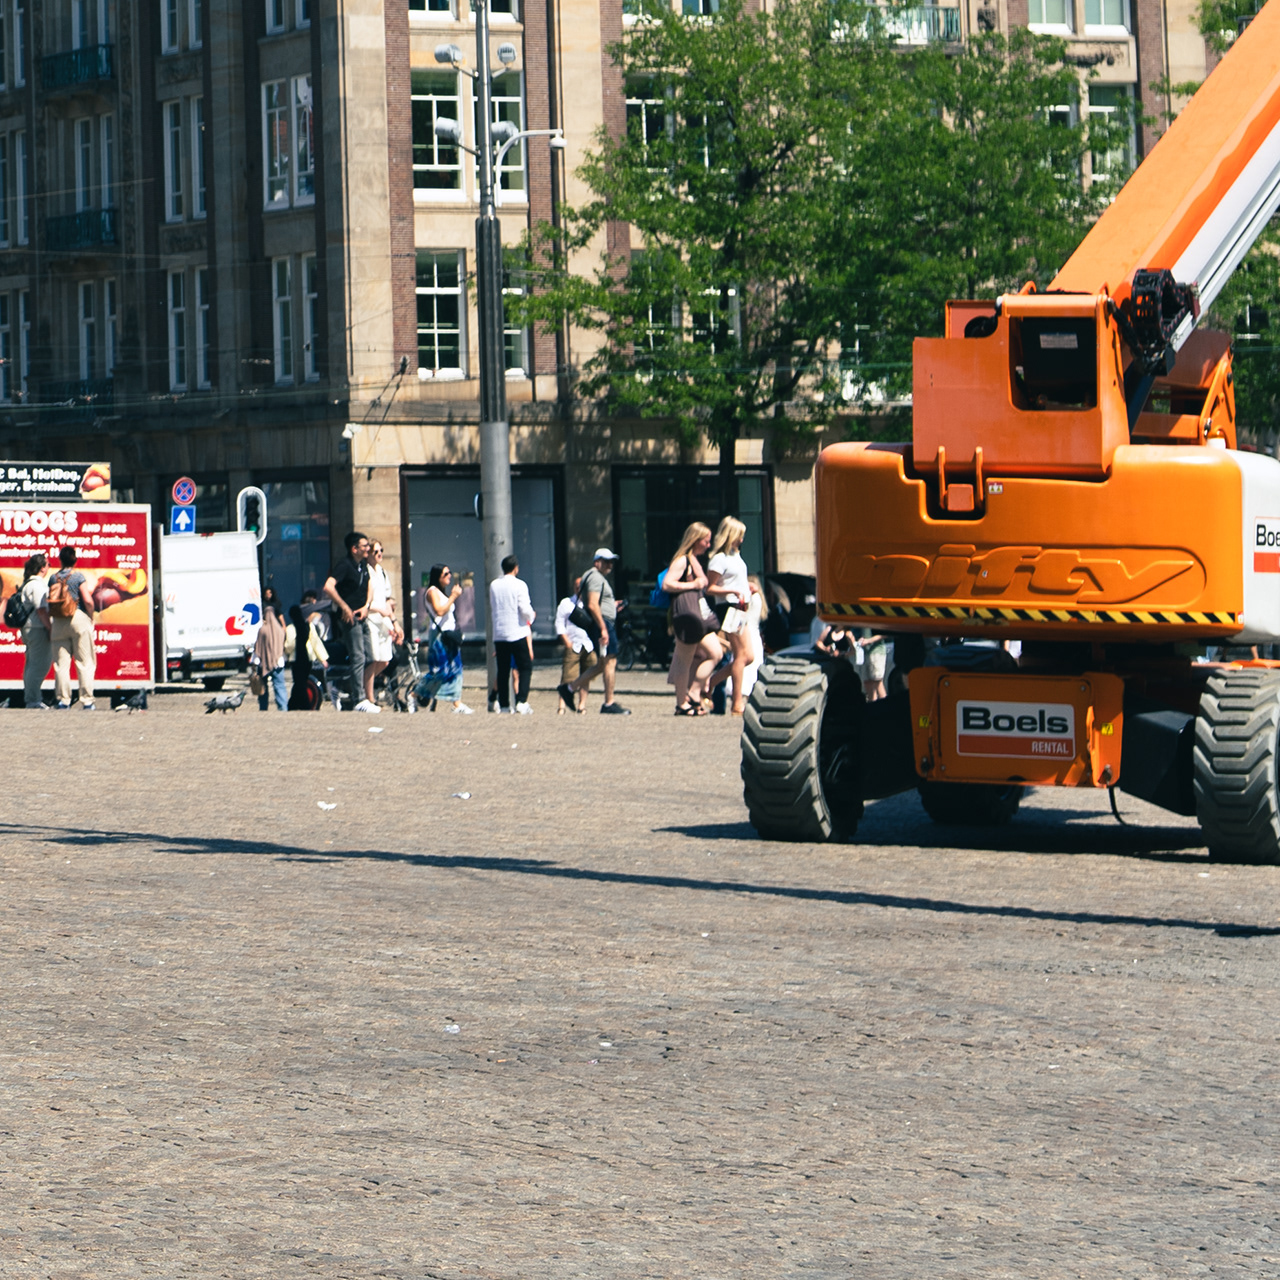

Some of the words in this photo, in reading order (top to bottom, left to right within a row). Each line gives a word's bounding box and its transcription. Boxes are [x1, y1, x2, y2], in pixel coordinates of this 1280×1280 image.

[22, 480, 76, 492] Beenham
[1256, 524, 1280, 547] Boe
[962, 706, 1069, 735] Boels
[1031, 741, 1069, 754] RENTAL
